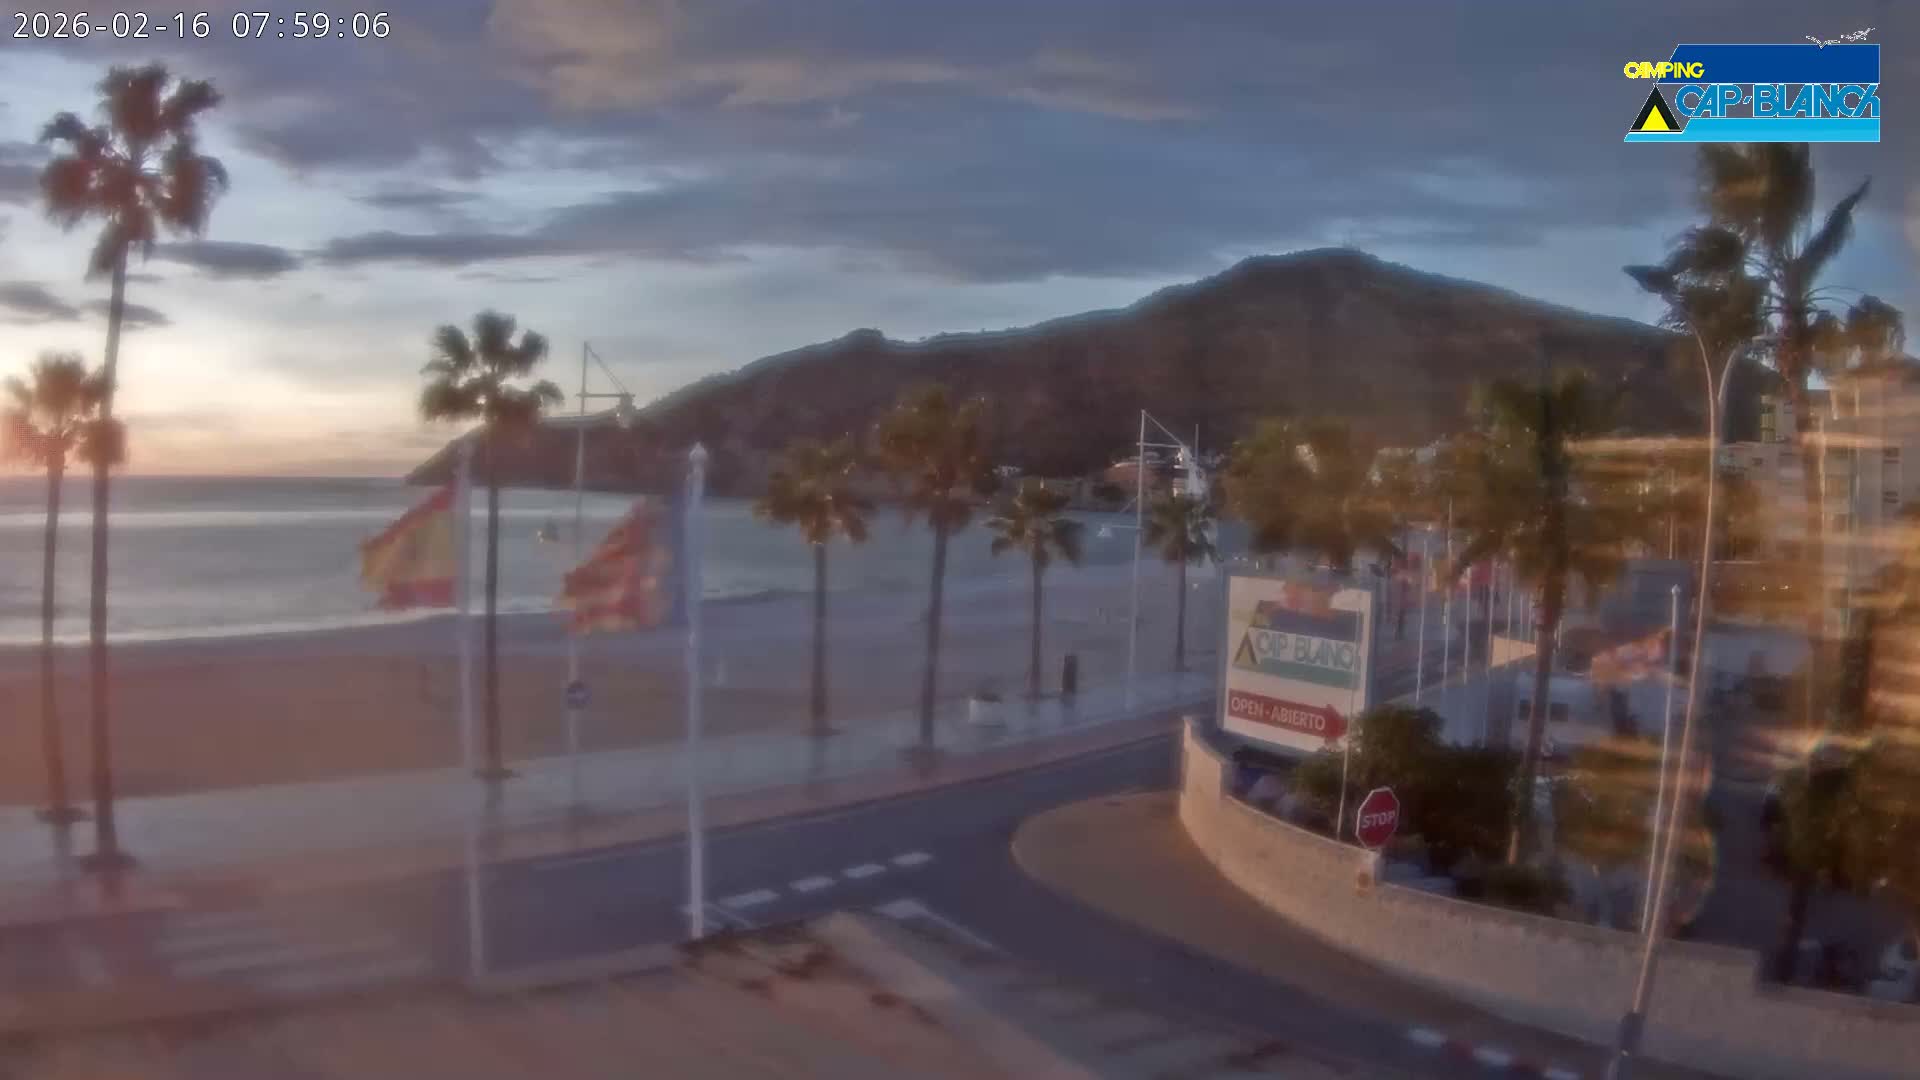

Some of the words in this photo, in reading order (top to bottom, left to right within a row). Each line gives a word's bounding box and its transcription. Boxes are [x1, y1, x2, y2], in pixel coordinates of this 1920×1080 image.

[1231, 697, 1264, 717] OPEN
[1271, 705, 1326, 731] ABIERTO
[1361, 810, 1396, 829] STOP
